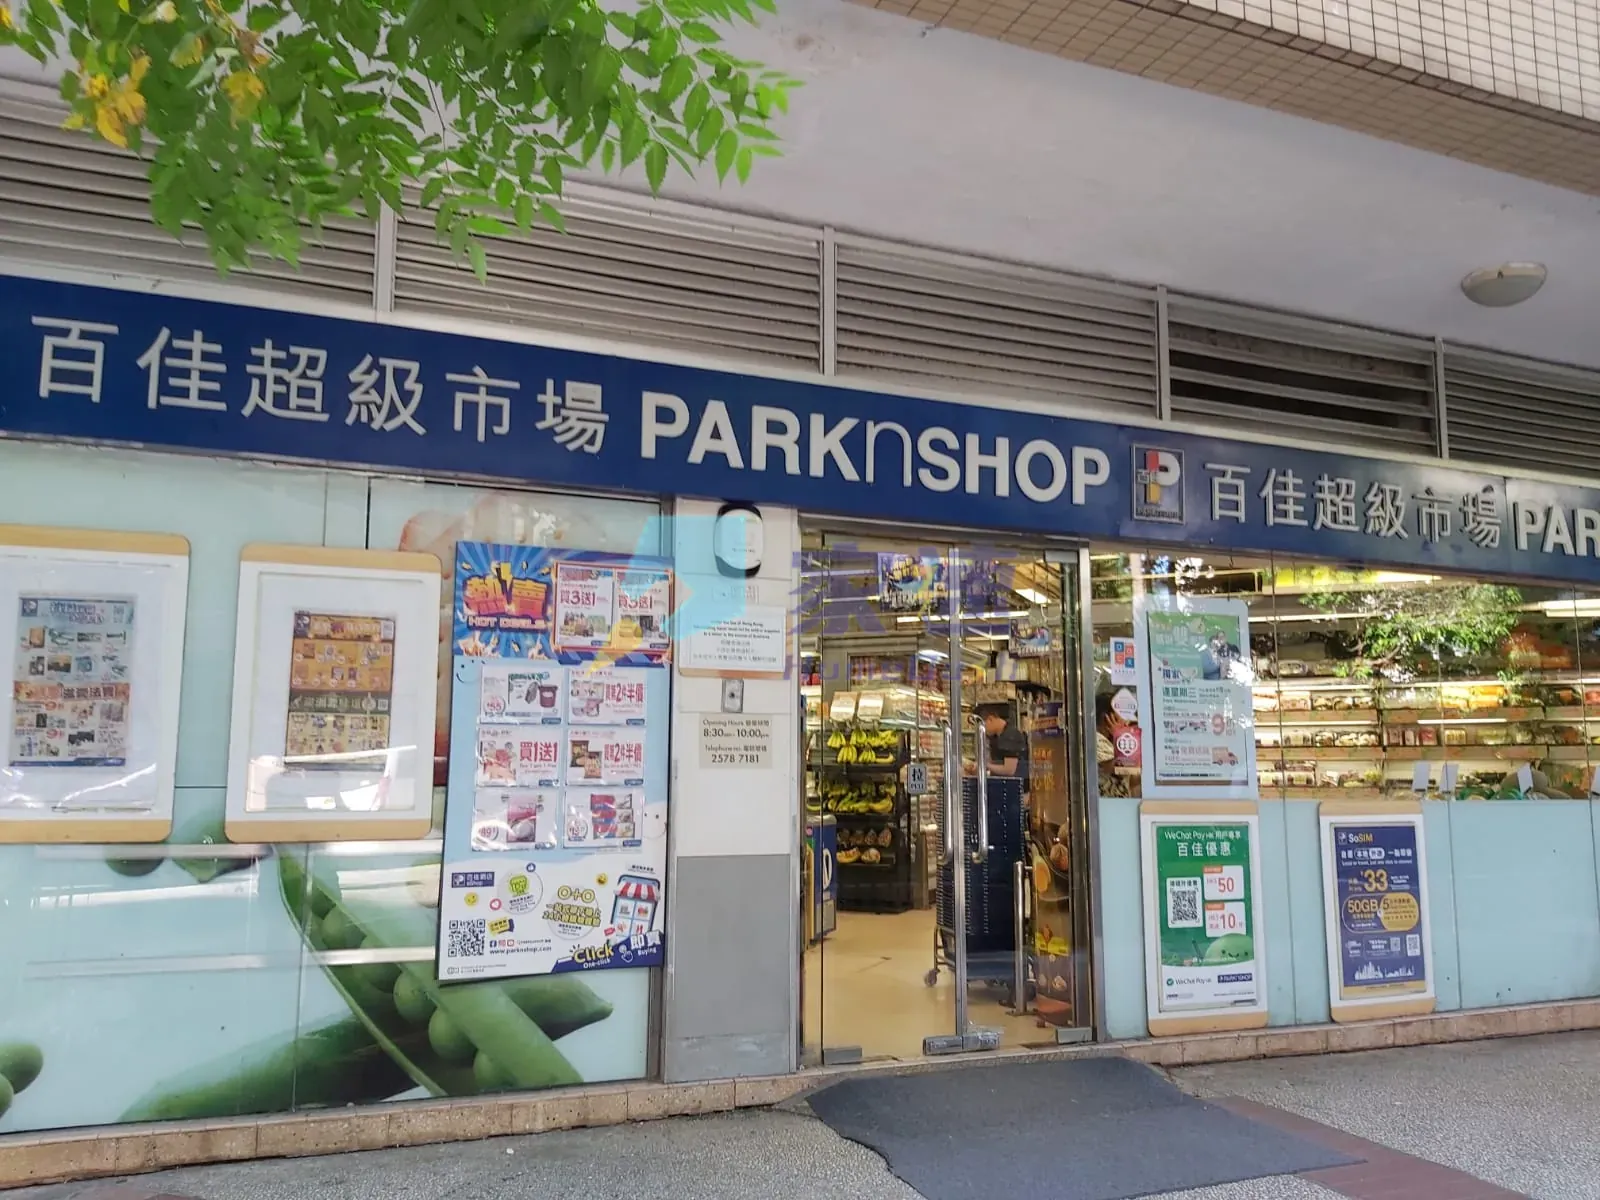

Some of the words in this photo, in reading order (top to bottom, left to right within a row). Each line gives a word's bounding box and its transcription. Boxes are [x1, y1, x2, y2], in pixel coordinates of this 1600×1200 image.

[31, 314, 610, 455] 百佳超級市場
[1203, 462, 1503, 549] 百佳超級市場
[468, 614, 498, 628] HOT
[702, 719, 727, 727] Opening
[519, 741, 558, 763] 買1送1
[705, 744, 733, 753] Telephone
[711, 754, 736, 764] 2578
[738, 754, 760, 764] 7181
[912, 768, 925, 782] 拉
[1164, 830, 1192, 840] WeChat
[1192, 830, 1206, 841] Pay
[1177, 841, 1232, 857] 百佳優惠
[1218, 877, 1235, 893] 50
[1347, 898, 1379, 914] 50GB
[1219, 913, 1236, 929] 10
[1175, 976, 1195, 985] WeChat
